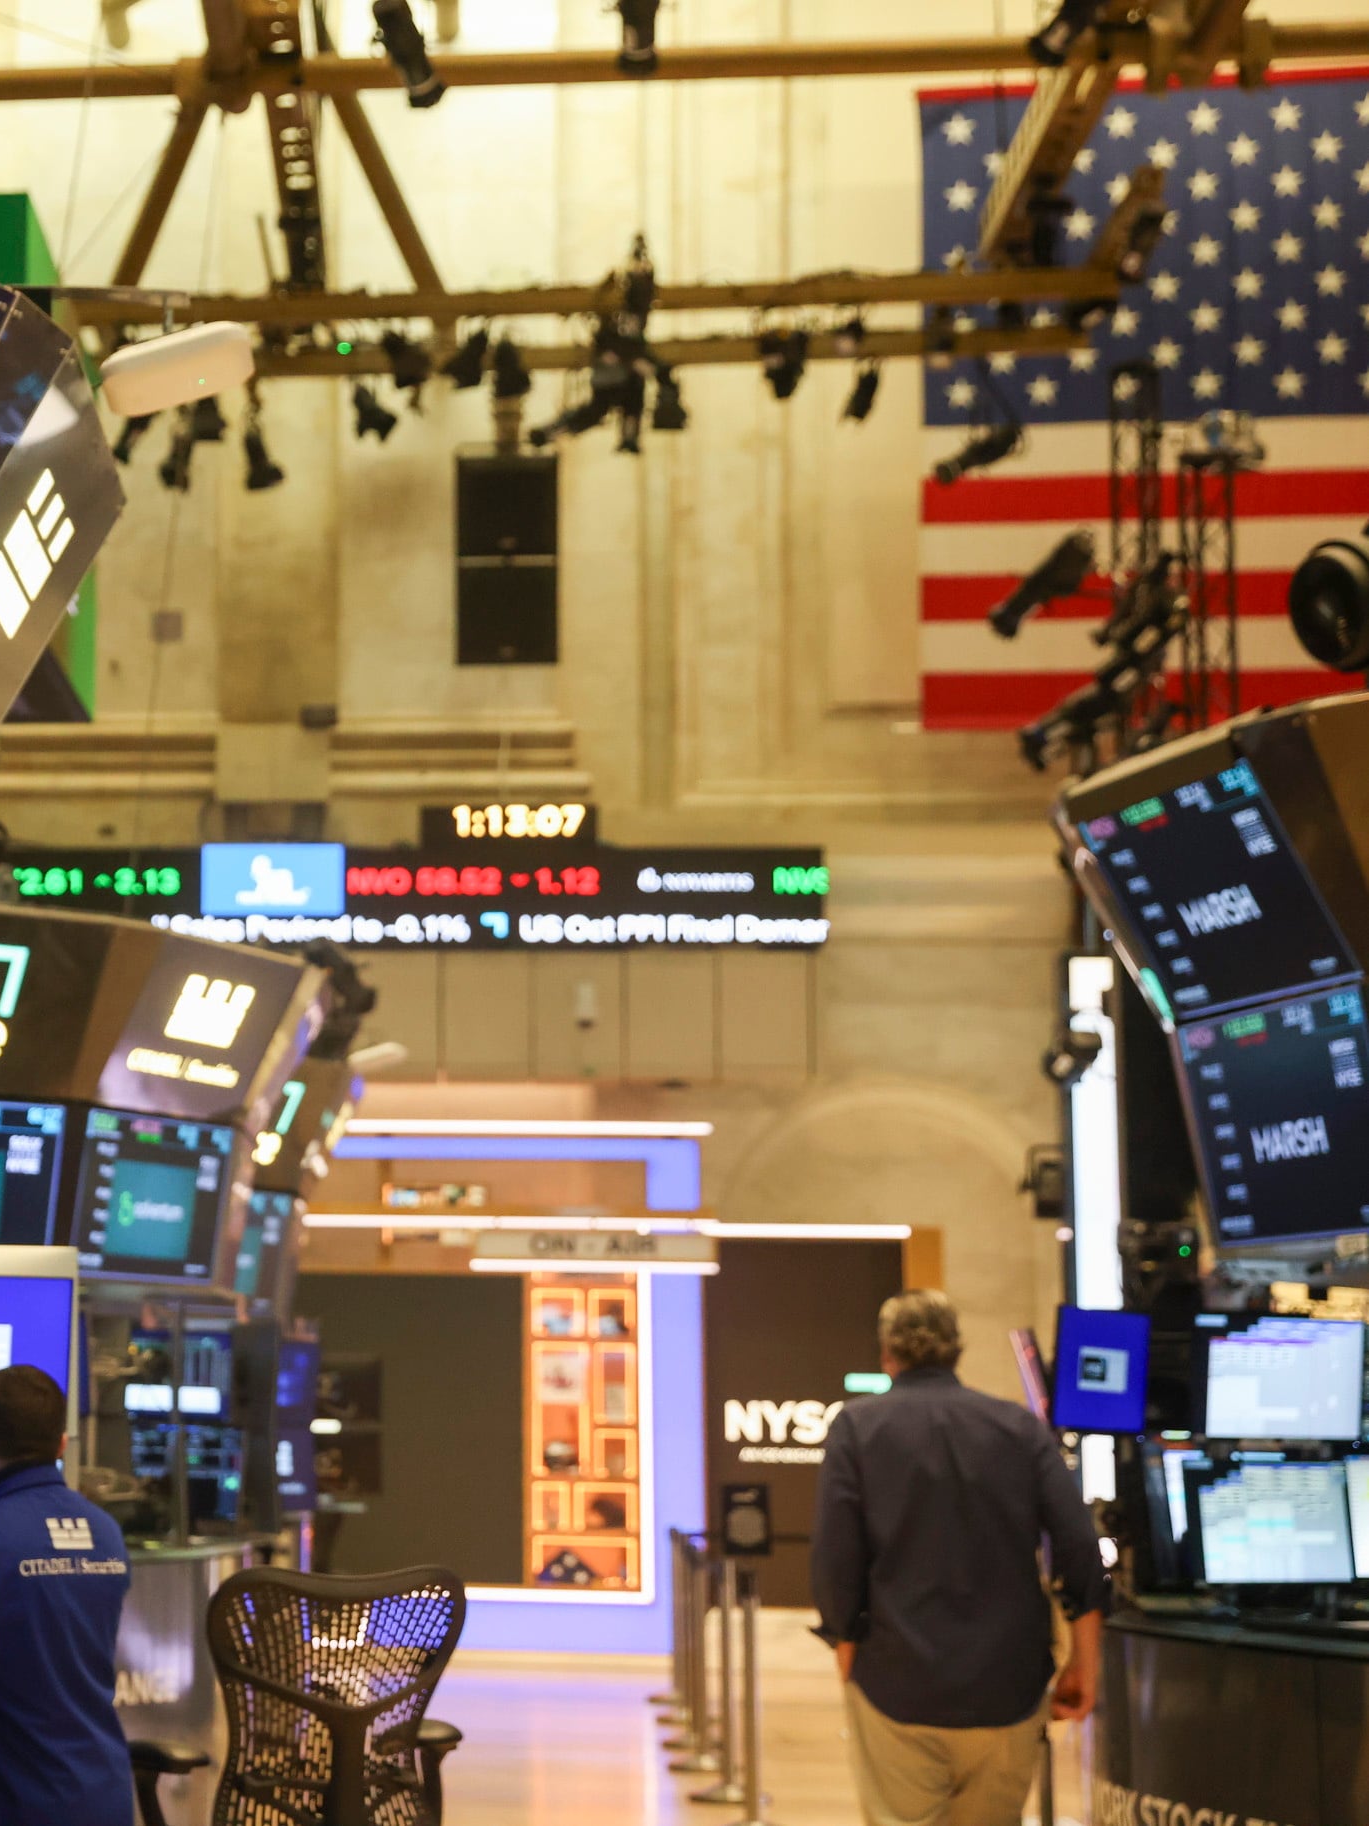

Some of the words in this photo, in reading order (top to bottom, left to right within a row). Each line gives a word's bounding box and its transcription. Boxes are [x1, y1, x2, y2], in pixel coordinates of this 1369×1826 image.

[452, 804, 585, 837] 1:13:07
[1176, 884, 1263, 936] MARSH
[1249, 1115, 1330, 1164] MARSH
